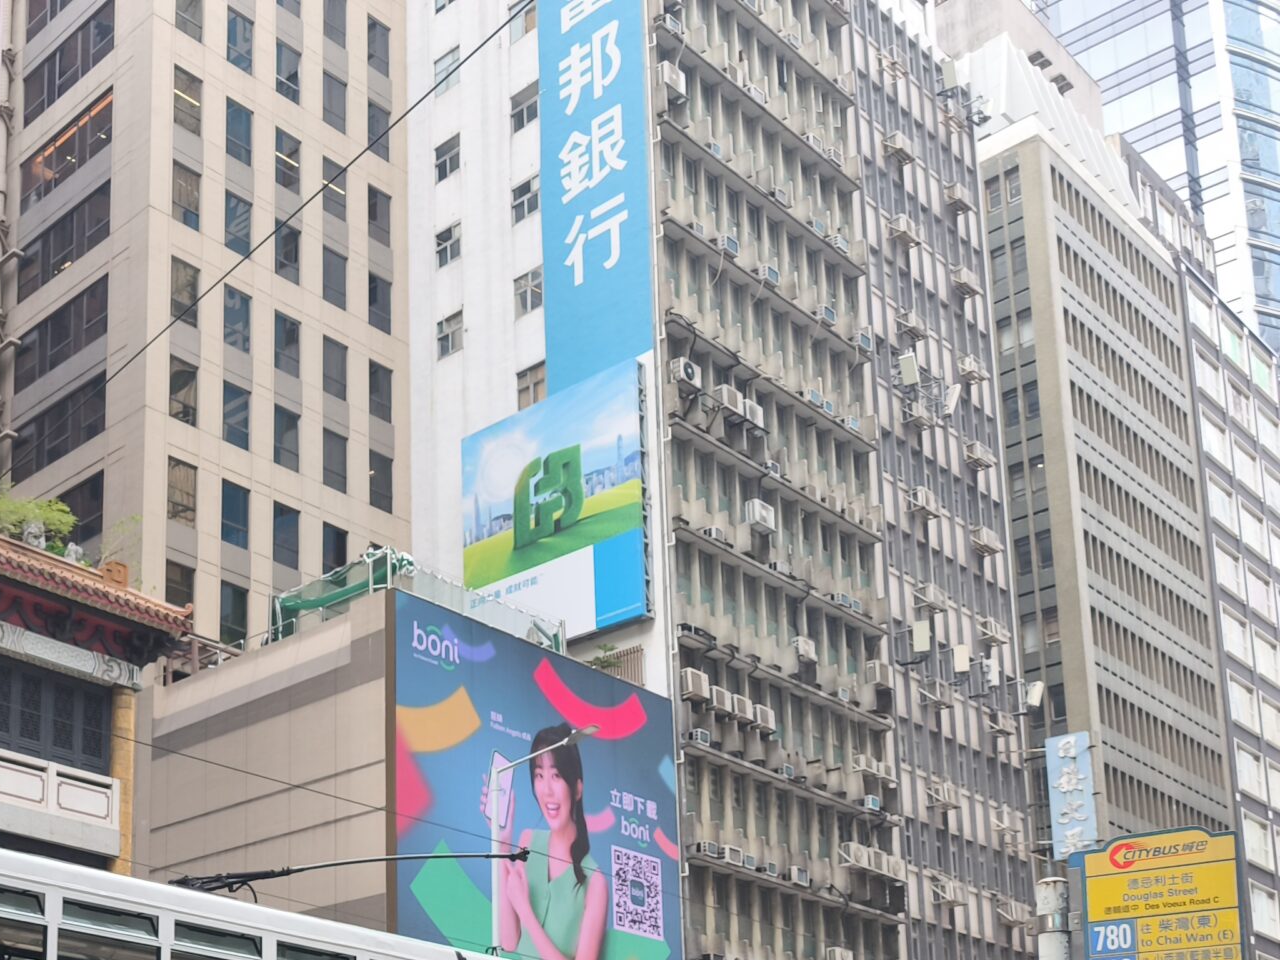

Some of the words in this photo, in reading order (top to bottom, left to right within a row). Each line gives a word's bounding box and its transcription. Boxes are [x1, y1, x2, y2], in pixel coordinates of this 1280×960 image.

[412, 620, 460, 664] boni
[610, 789, 658, 820] 立即下載
[621, 816, 650, 842] boni
[1123, 845, 1179, 862] CITYBUS
[1122, 890, 1164, 902] Douglas
[1168, 887, 1198, 897] Street
[1144, 903, 1160, 911] Des
[1162, 900, 1187, 909] Voeux
[1189, 898, 1211, 906] Road
[1213, 896, 1220, 904] C
[1094, 924, 1131, 951] 780
[1141, 937, 1152, 947] to
[1156, 933, 1182, 946] Chai
[1186, 932, 1213, 943] Wan
[1218, 930, 1234, 942] (E)
